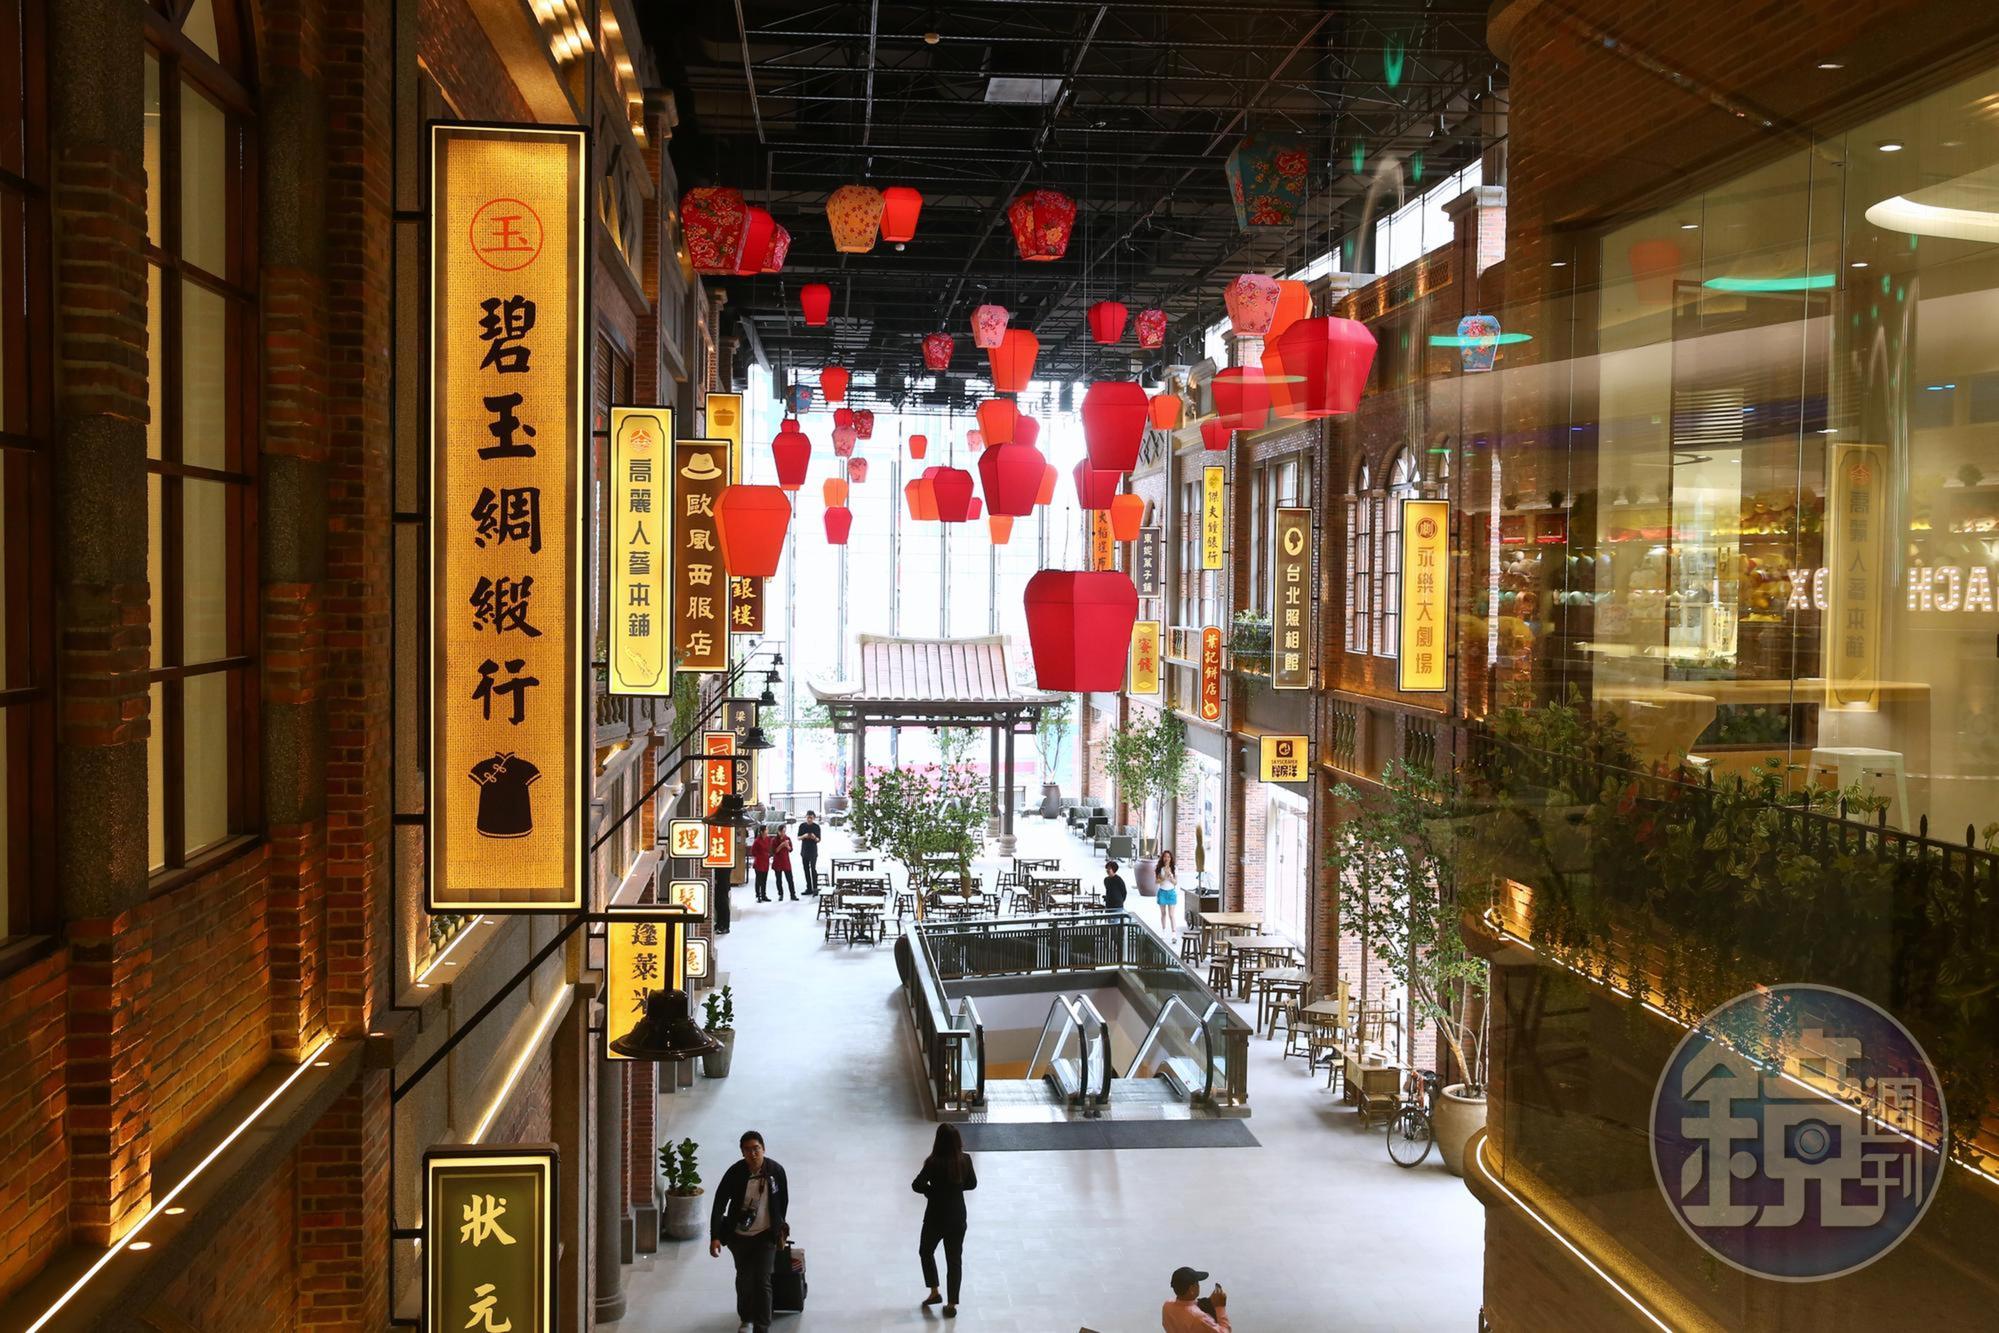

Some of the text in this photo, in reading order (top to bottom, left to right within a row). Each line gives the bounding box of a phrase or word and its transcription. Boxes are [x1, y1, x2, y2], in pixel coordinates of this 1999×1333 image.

[482, 213, 535, 253] 玉
[470, 297, 542, 725] 碧玉綢緞行
[686, 493, 716, 657] 歐風西服店
[732, 578, 756, 627] 銀樓
[1285, 563, 1300, 671] 台北照相館
[1416, 546, 1434, 674] 永樂大劇場
[1137, 638, 1154, 673] 蜜餞
[1204, 634, 1218, 695] 葉記餅店
[678, 828, 699, 850] 理
[678, 888, 698, 912] 髮
[460, 1193, 517, 1333] 狀元
